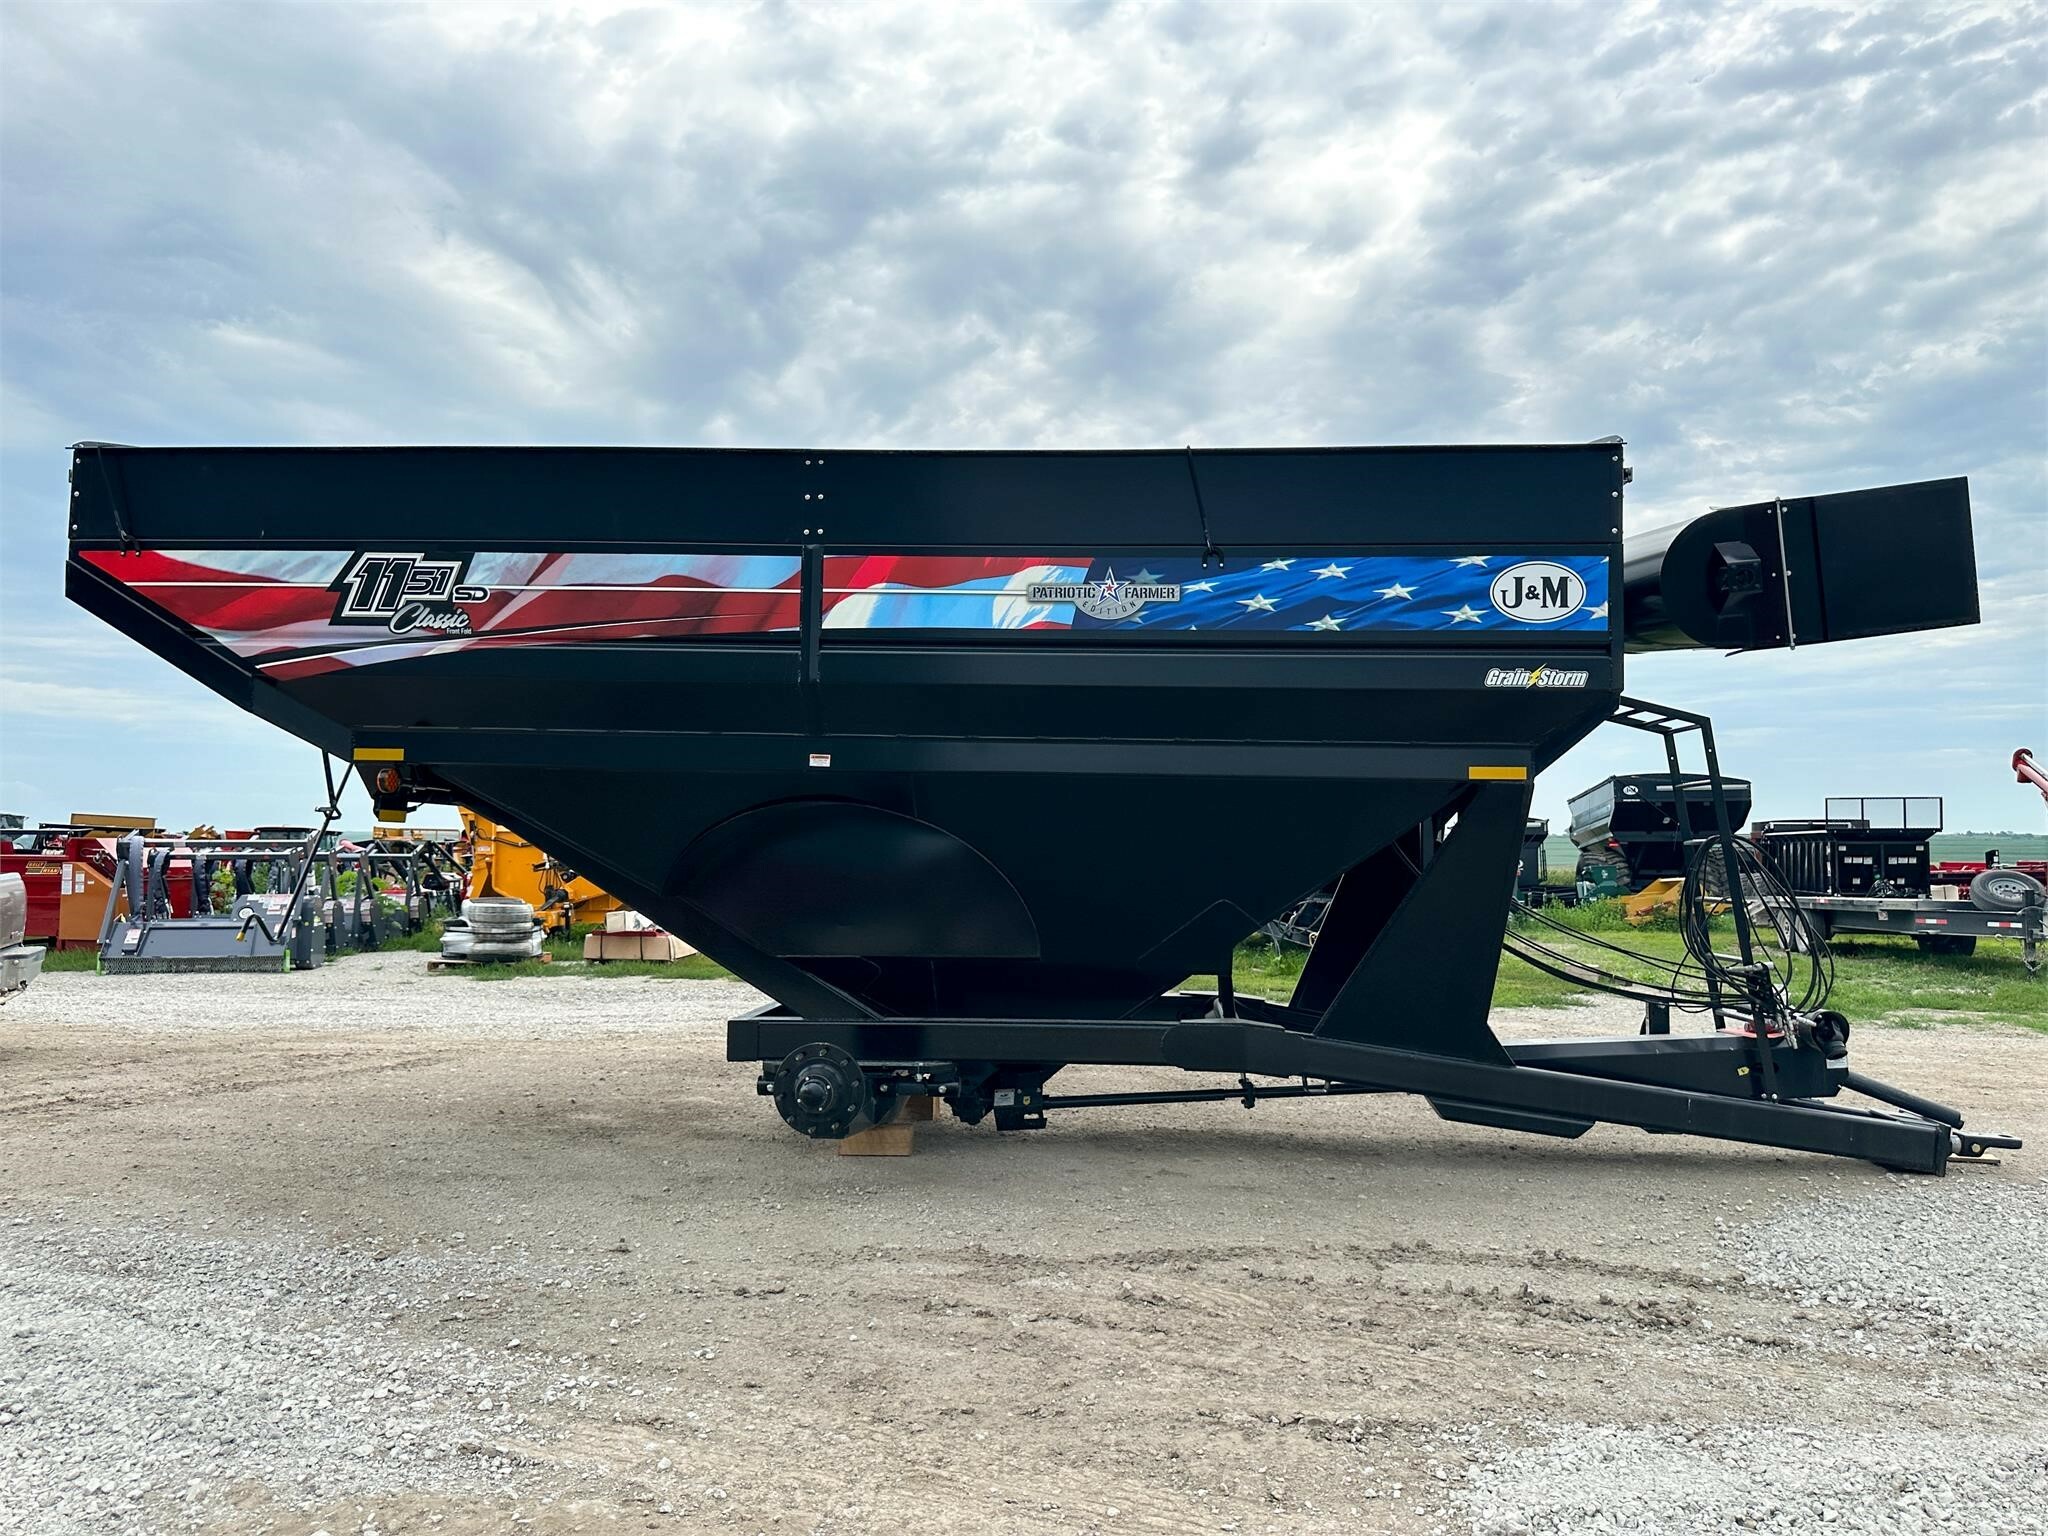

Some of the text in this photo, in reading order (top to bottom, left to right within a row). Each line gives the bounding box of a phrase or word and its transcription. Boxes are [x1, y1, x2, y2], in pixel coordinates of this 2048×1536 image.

[1033, 586, 1175, 599] PATRIOTIC FARMER
[1500, 576, 1571, 609] J&M
[390, 602, 470, 634] Classic
[1081, 600, 1137, 615] EDITION
